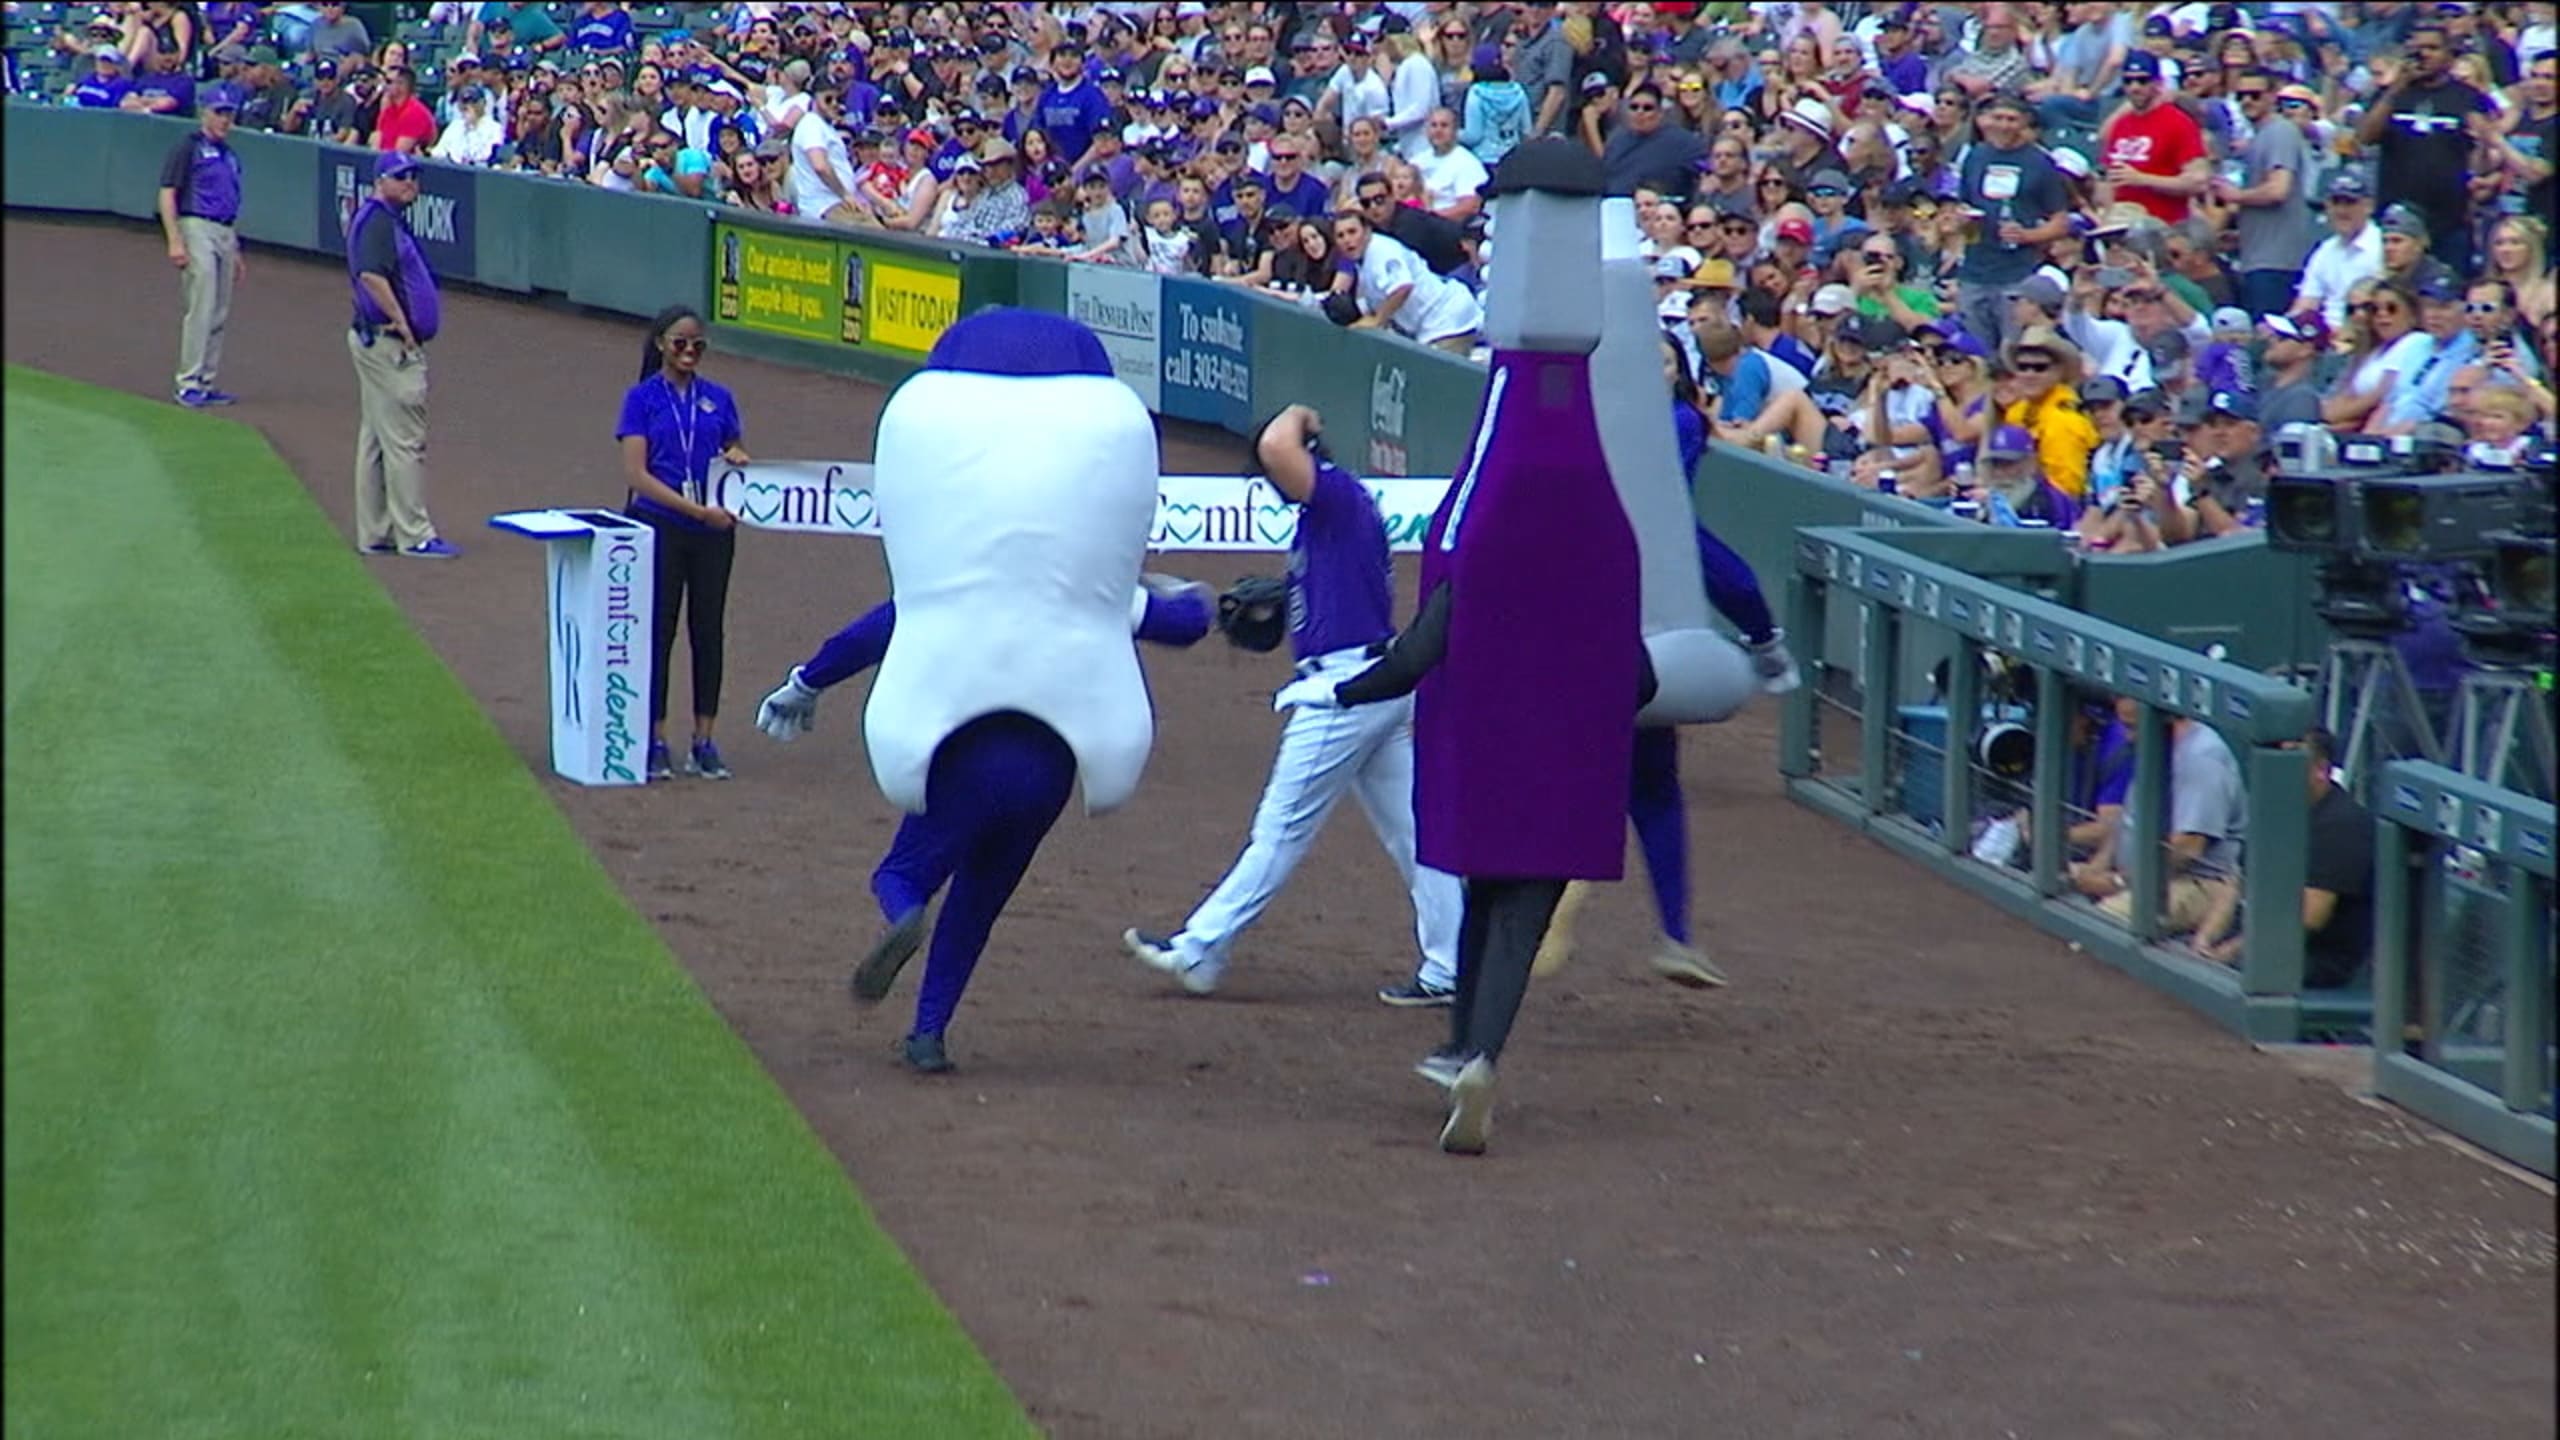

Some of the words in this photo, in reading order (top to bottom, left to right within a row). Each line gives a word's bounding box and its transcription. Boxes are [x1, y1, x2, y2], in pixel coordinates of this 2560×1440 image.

[358, 184, 455, 242] NWORK
[747, 246, 766, 273] Our
[767, 250, 804, 280] animals
[806, 257, 831, 286] need
[747, 282, 780, 316] people
[781, 284, 800, 314] like
[877, 287, 908, 324] VISIT
[910, 292, 958, 332] TODAY
[1179, 302, 1199, 341] To
[1165, 348, 1190, 386] call
[716, 465, 882, 529] Comfo
[1149, 480, 1306, 543] omfo
[606, 544, 638, 667] Comfort
[603, 670, 639, 784] dental
